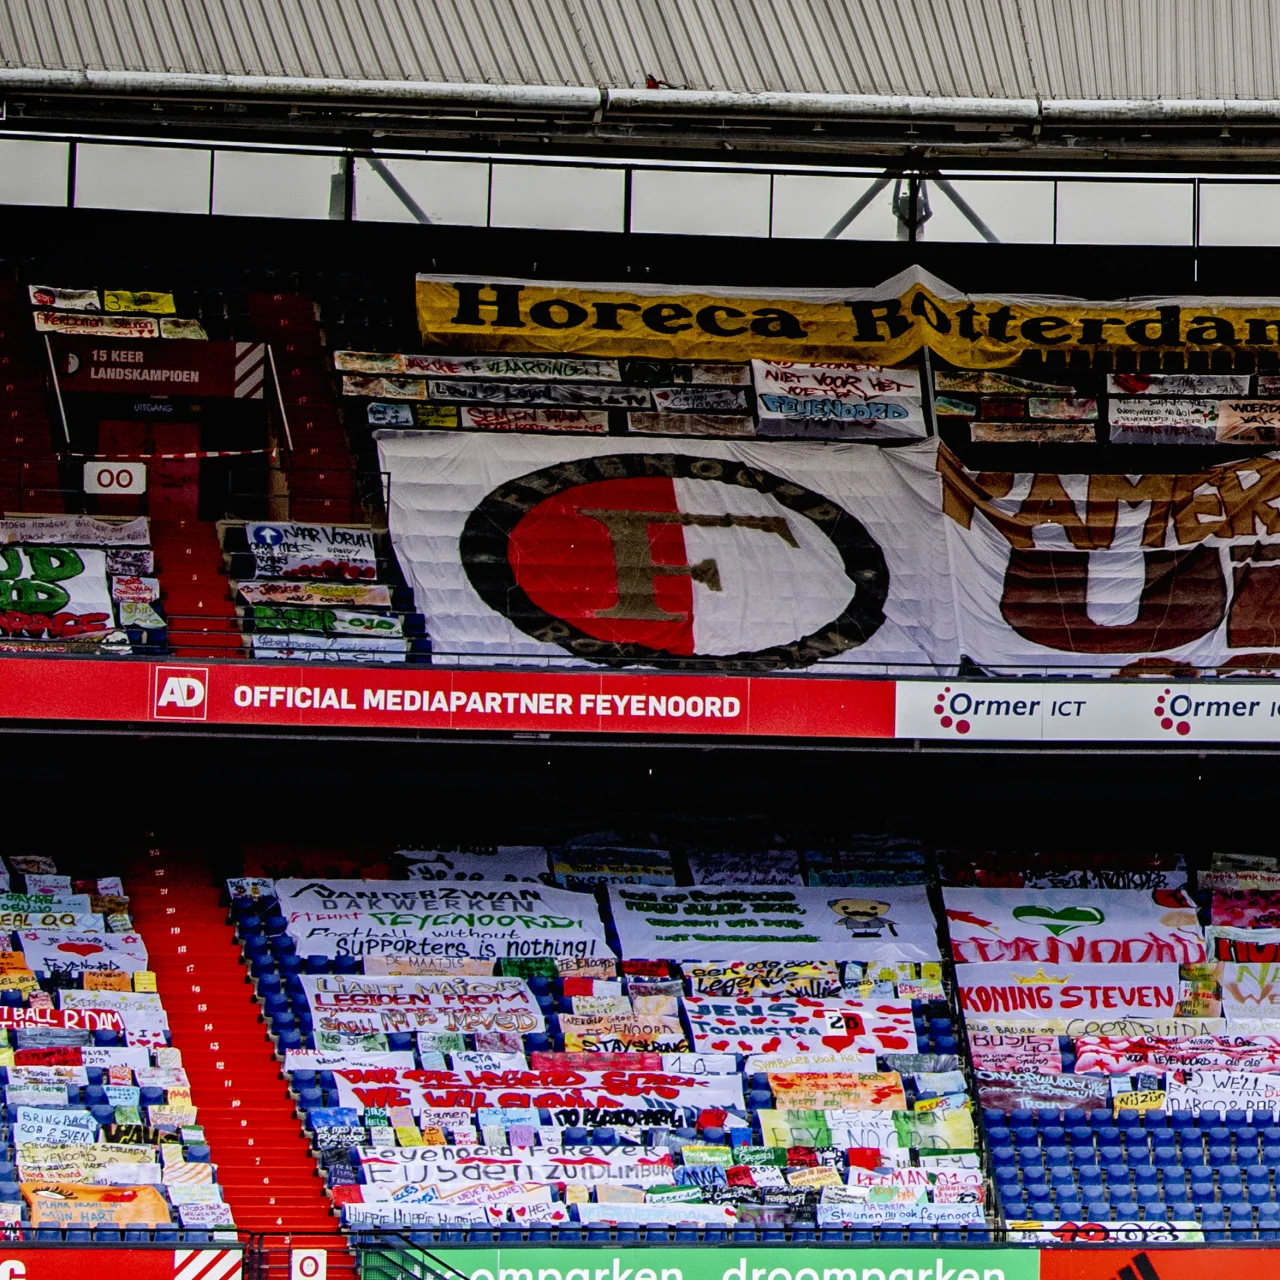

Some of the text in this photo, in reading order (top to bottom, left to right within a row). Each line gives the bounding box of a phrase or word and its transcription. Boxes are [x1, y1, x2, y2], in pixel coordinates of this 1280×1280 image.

[451, 282, 808, 339] Horeca
[91, 350, 144, 363] 15 KEER
[90, 367, 200, 384] LANDSKAMPIOEN
[765, 370, 809, 384] NIET
[811, 372, 863, 388] VOOR
[133, 403, 173, 413] UITGANG
[759, 393, 910, 421] FEYENOORD
[157, 676, 741, 718] AD OFFICIAL MEDIAPARTNER FEYENOORD
[949, 693, 1087, 717] Ormer ICT
[1169, 693, 1261, 718] Ormer
[322, 899, 534, 913] DAKWERKEN
[960, 984, 1175, 1012] KONING STEVEN
[11, 1006, 126, 1032] BALL R'DAM
[687, 1003, 859, 1031] JENS 20
[695, 1020, 823, 1037] TOORNSTRA
[1211, 1076, 1260, 1092] WE'LL
[21, 1111, 63, 1125] BRING
[423, 1108, 469, 1120] Samen
[20, 1123, 91, 1143] ROB SVEN
[84, 1209, 116, 1223] HART
